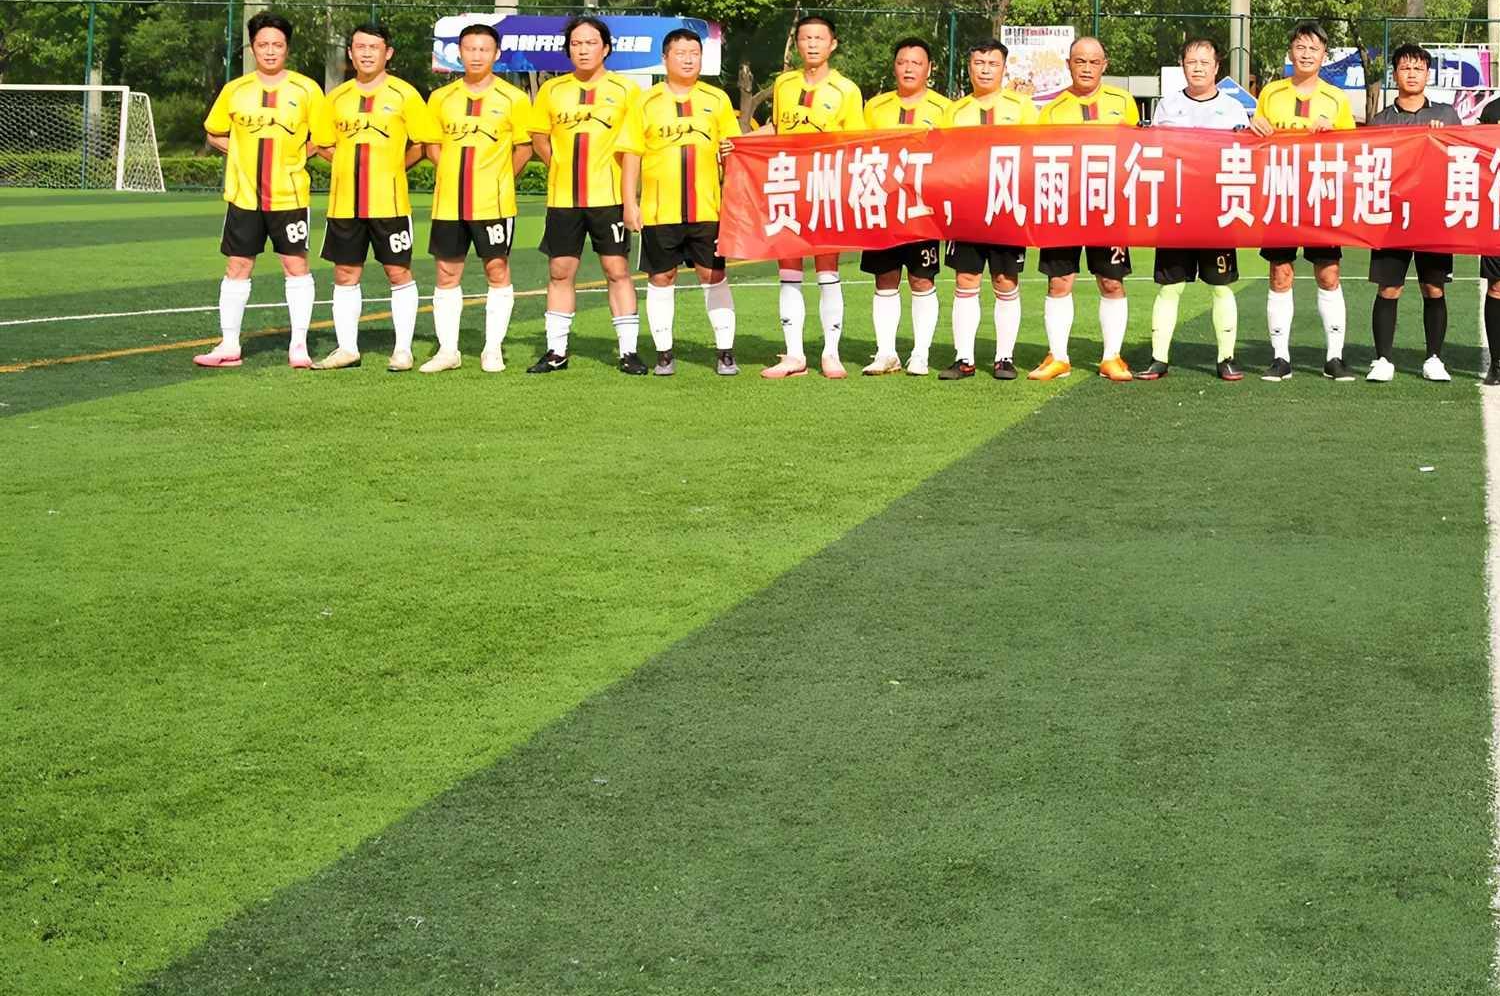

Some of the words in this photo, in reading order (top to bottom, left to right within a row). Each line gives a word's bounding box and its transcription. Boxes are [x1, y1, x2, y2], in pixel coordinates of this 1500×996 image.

[286, 220, 308, 243] 83
[389, 230, 411, 253] 69
[486, 223, 505, 245] 18
[920, 247, 938, 267] 39
